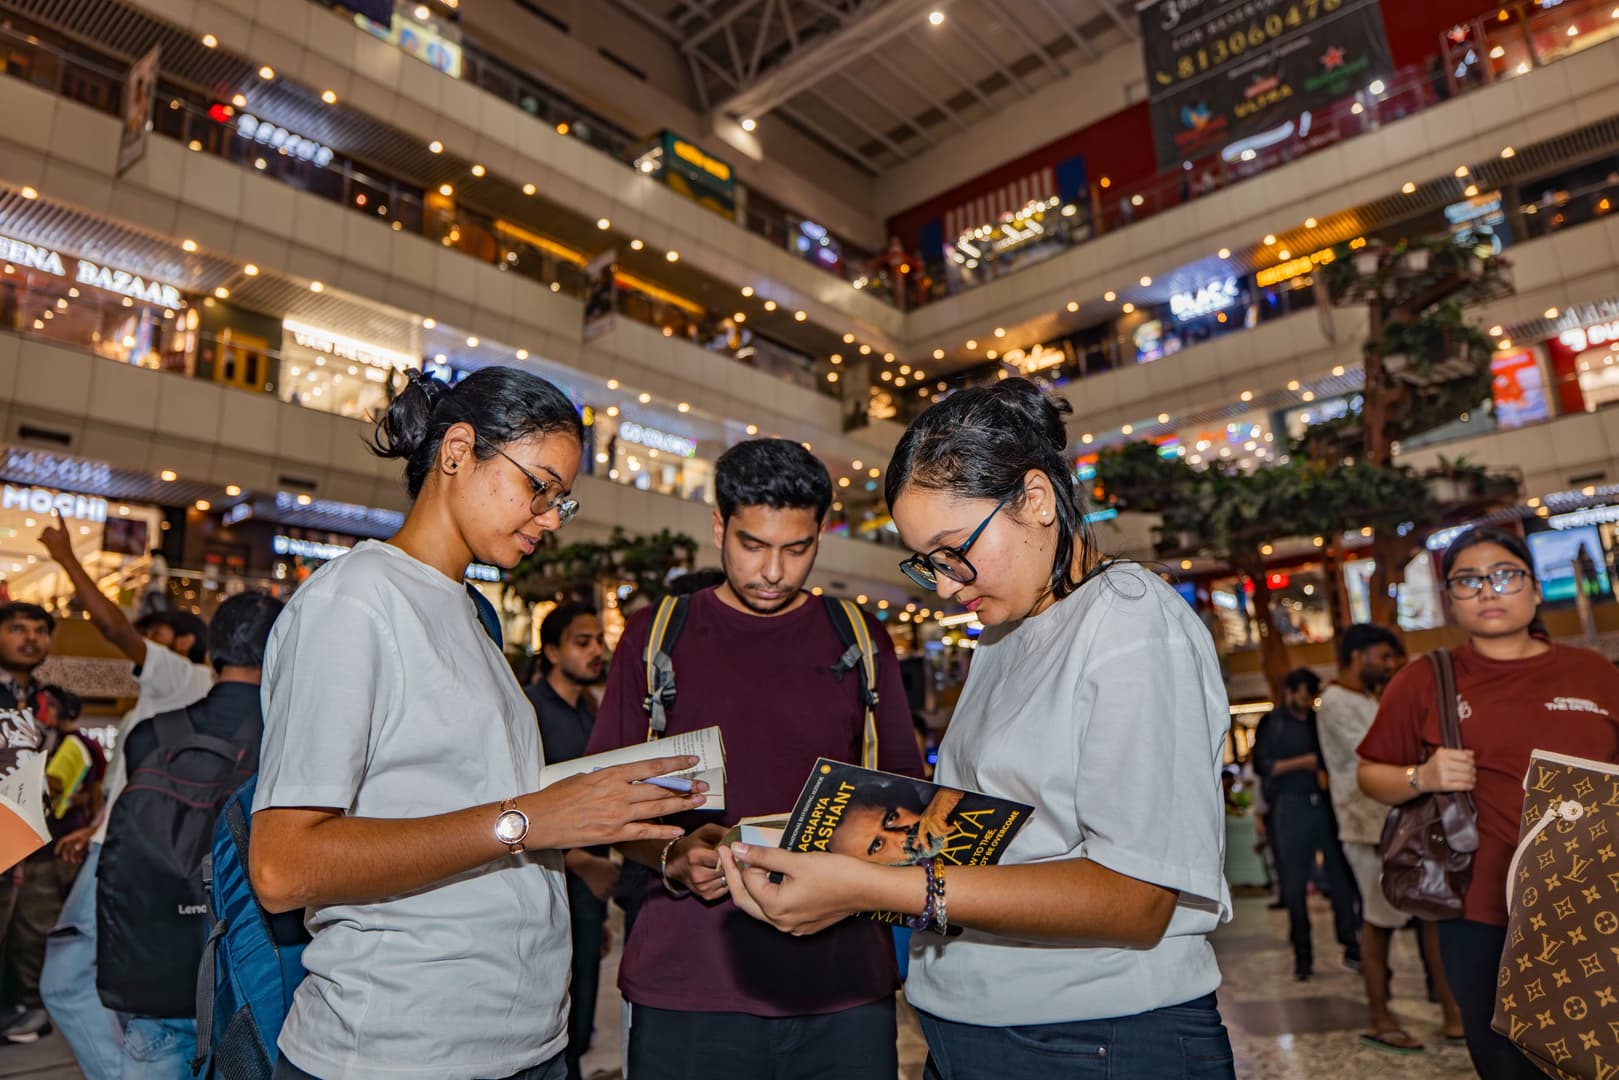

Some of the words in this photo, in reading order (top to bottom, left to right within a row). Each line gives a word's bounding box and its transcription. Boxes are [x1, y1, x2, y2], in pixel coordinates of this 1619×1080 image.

[76, 259, 182, 310] BAZAAR
[3, 484, 108, 522] MOCHI
[798, 797, 830, 852] ACHARYA
[813, 781, 856, 851] ASHANT
[938, 808, 996, 866] AYA
[991, 810, 1020, 847] OVERCOME
[973, 846, 984, 858] TO
[178, 904, 208, 915] Leno
